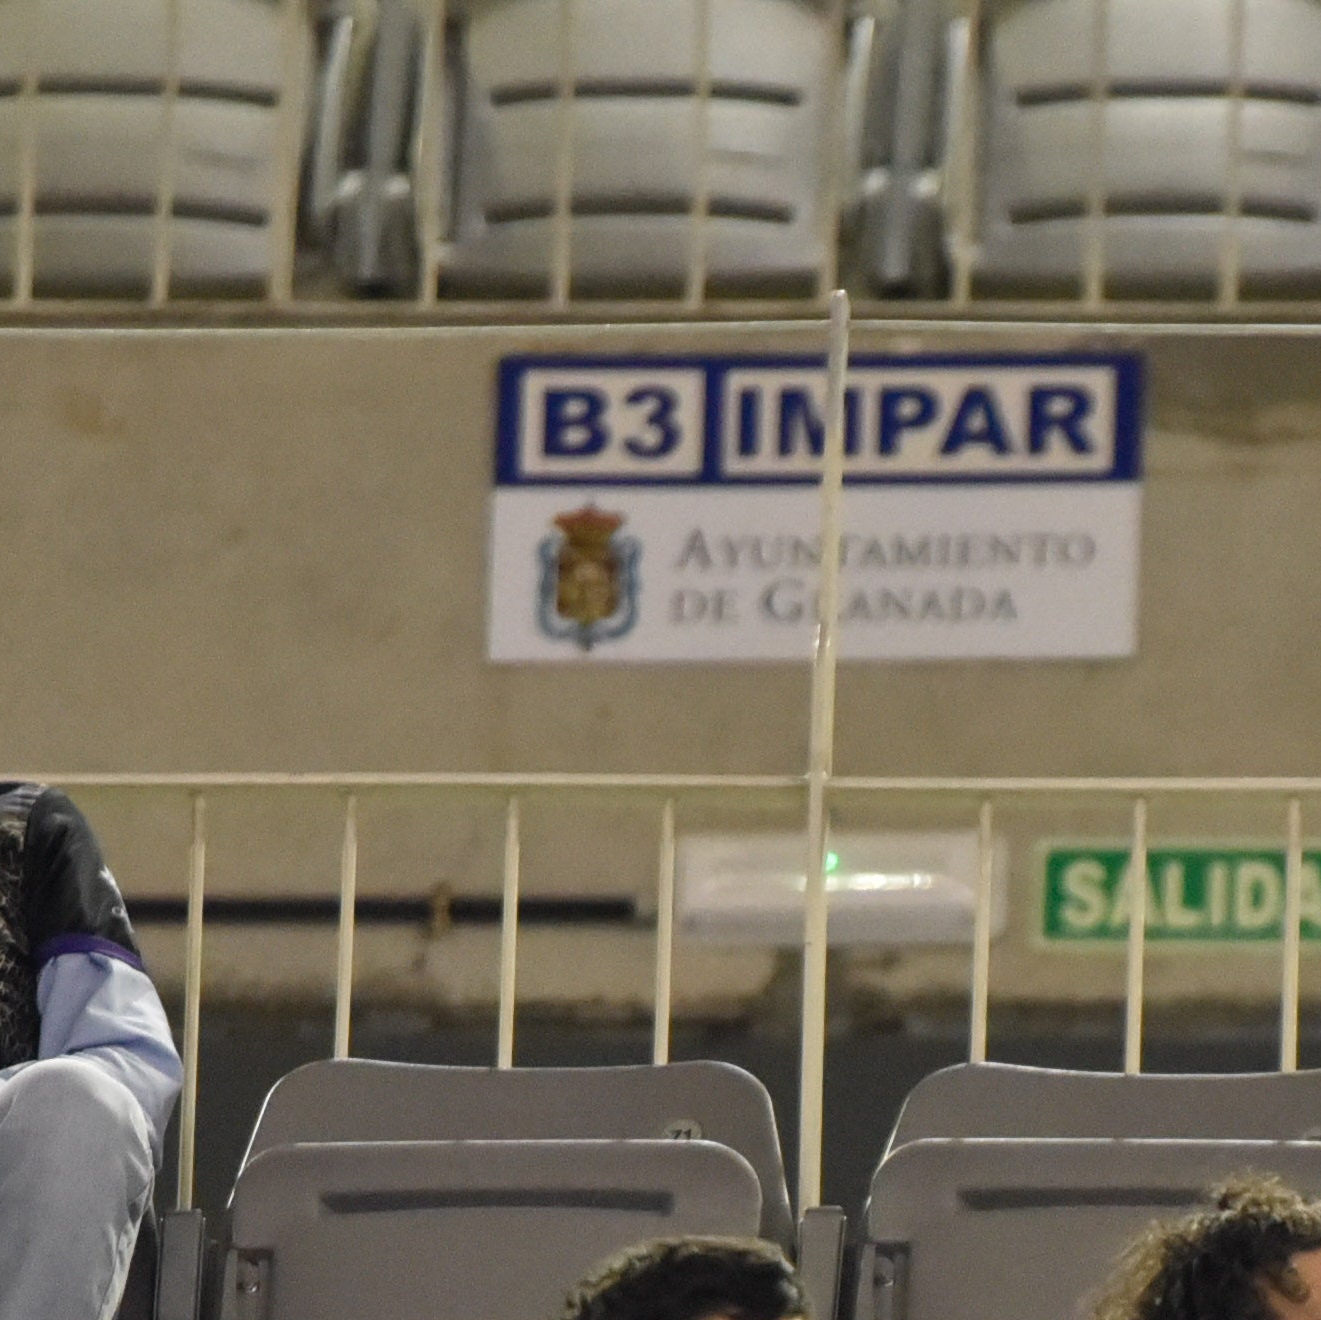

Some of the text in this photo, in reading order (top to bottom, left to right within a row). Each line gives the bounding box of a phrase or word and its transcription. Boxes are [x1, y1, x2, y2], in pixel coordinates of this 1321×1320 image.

[542, 384, 1099, 459] B3 IMPAR
[669, 588, 735, 626] DE
